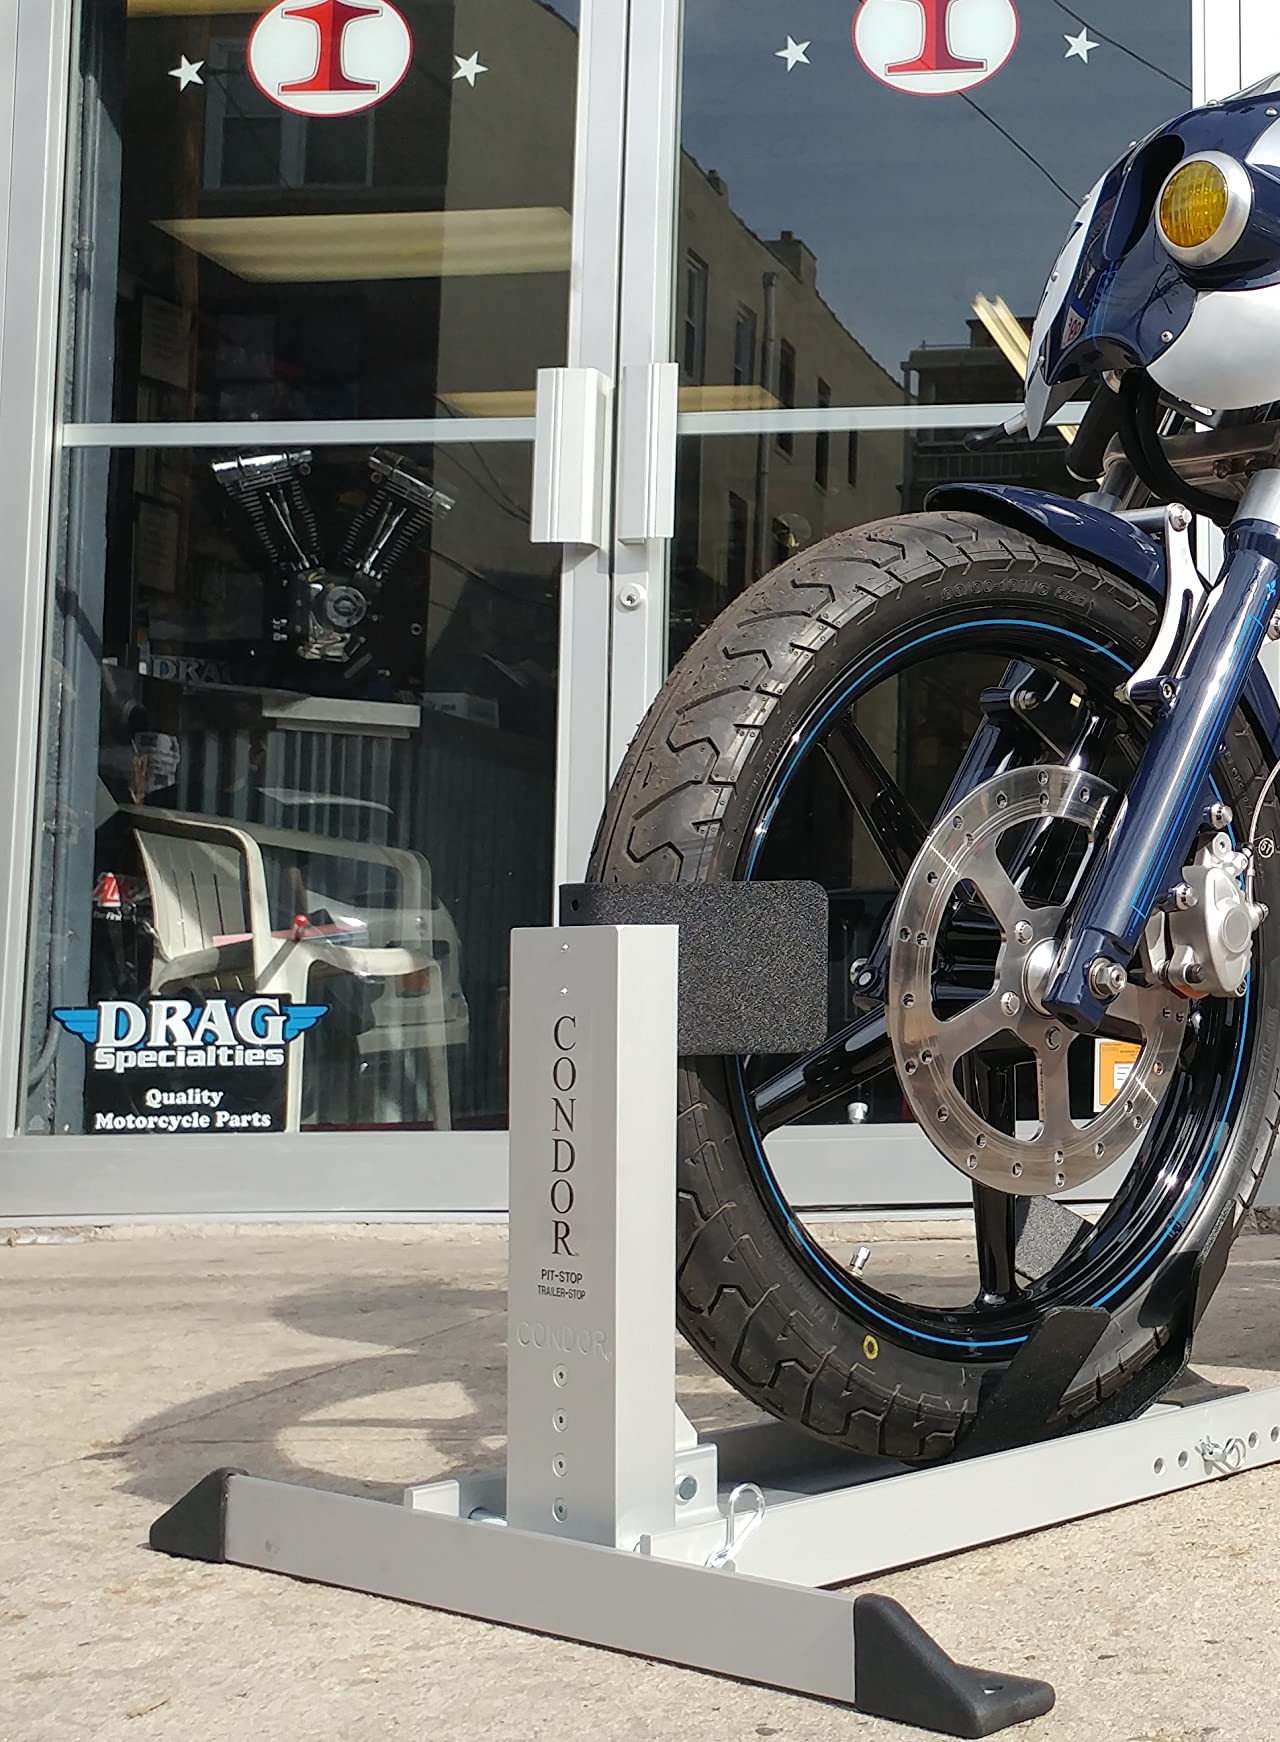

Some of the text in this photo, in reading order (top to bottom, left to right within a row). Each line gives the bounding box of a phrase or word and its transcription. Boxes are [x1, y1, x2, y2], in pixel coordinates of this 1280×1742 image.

[96, 998, 288, 1047] DRAG
[94, 1046, 285, 1073] Specialties
[145, 1088, 224, 1108] Quality
[95, 1111, 272, 1132] Motorcycle Parts
[550, 1015, 579, 1257] CONDOR
[541, 1268, 583, 1284] PIT-STOP
[537, 1285, 586, 1300] TRAILER-STOP
